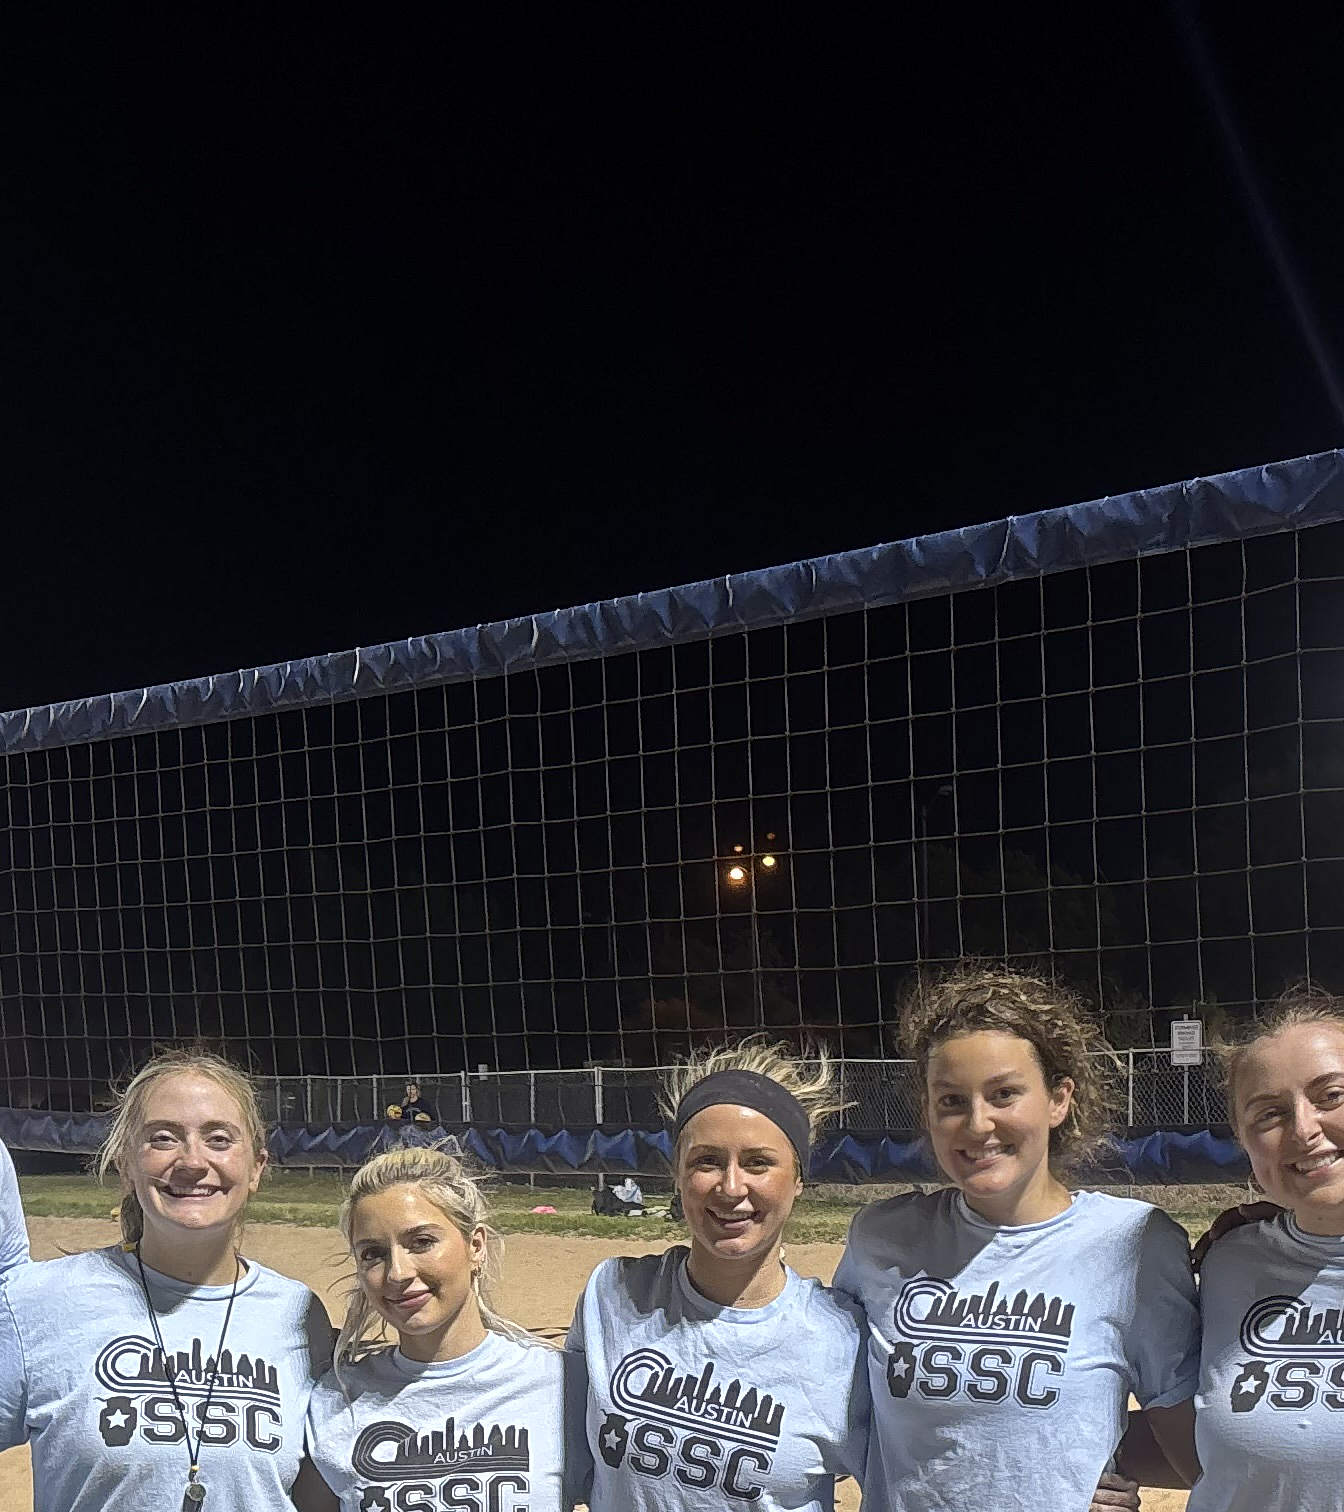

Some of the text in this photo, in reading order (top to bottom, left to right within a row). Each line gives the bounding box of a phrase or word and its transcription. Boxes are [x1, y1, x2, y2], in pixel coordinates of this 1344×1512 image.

[961, 1311, 1040, 1332] AUSTIN
[174, 1368, 253, 1388] AUSTIN
[916, 1342, 1066, 1408] SSC
[140, 1396, 284, 1452] SSC
[672, 1394, 753, 1427] AUSTIN
[433, 1444, 494, 1464] AUSTIN
[627, 1417, 774, 1501] SSC
